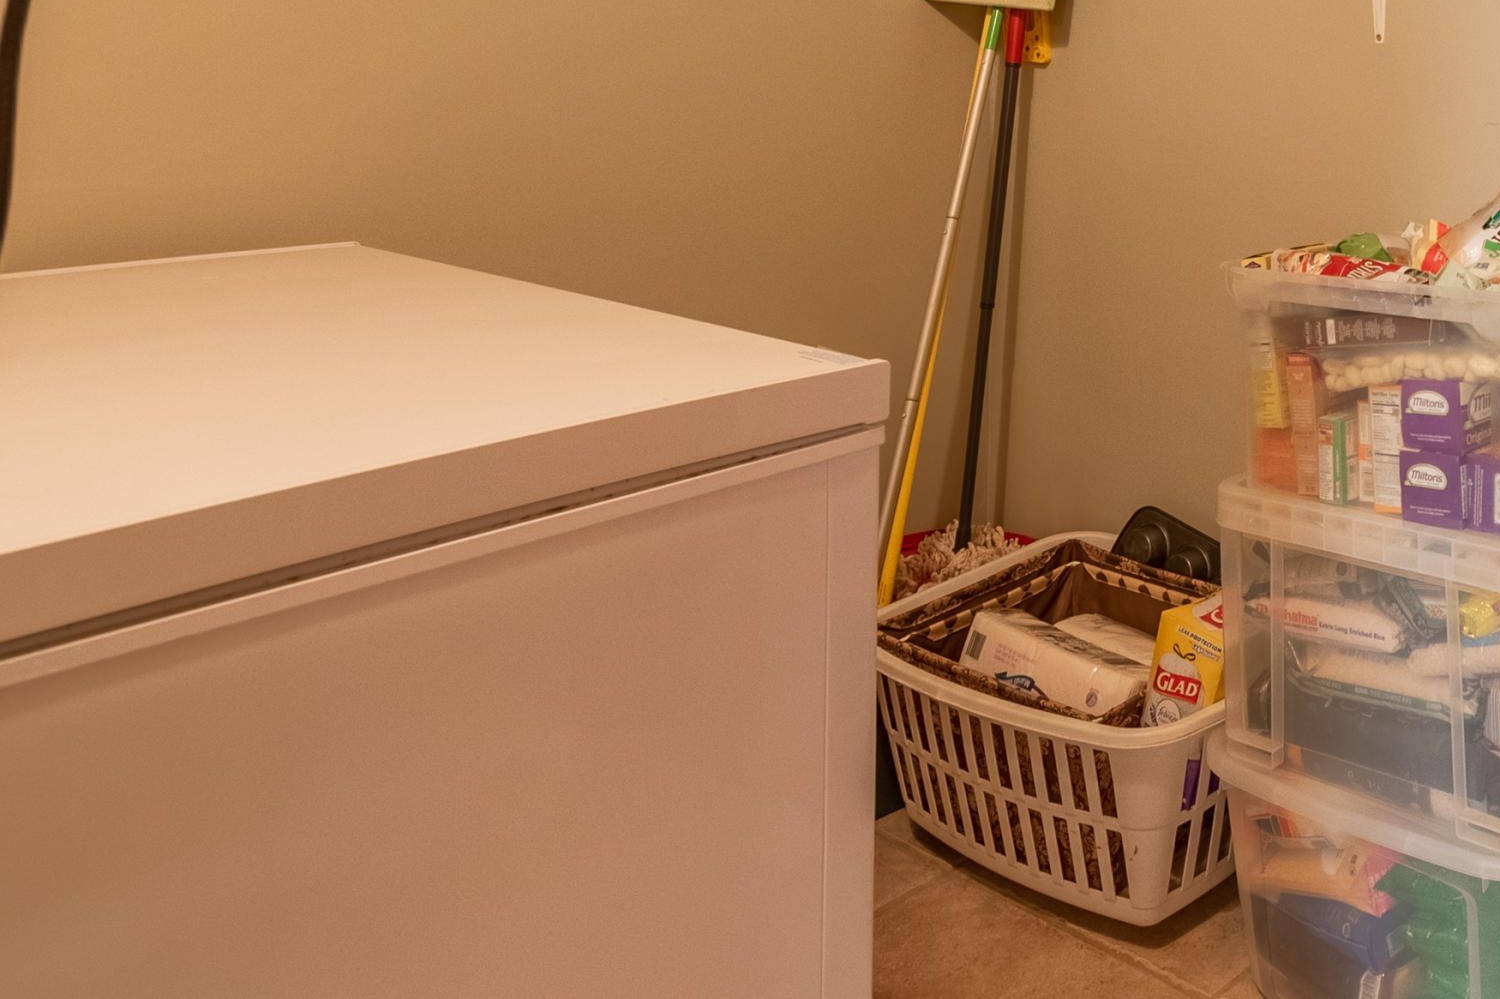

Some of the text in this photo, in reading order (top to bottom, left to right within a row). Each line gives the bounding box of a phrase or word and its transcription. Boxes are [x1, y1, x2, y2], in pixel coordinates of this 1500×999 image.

[1319, 621, 1333, 630] Extra
[1334, 624, 1348, 635] Long
[1349, 628, 1373, 639] Enriched
[1373, 633, 1385, 641] Rice
[1156, 671, 1201, 698] GLAD
